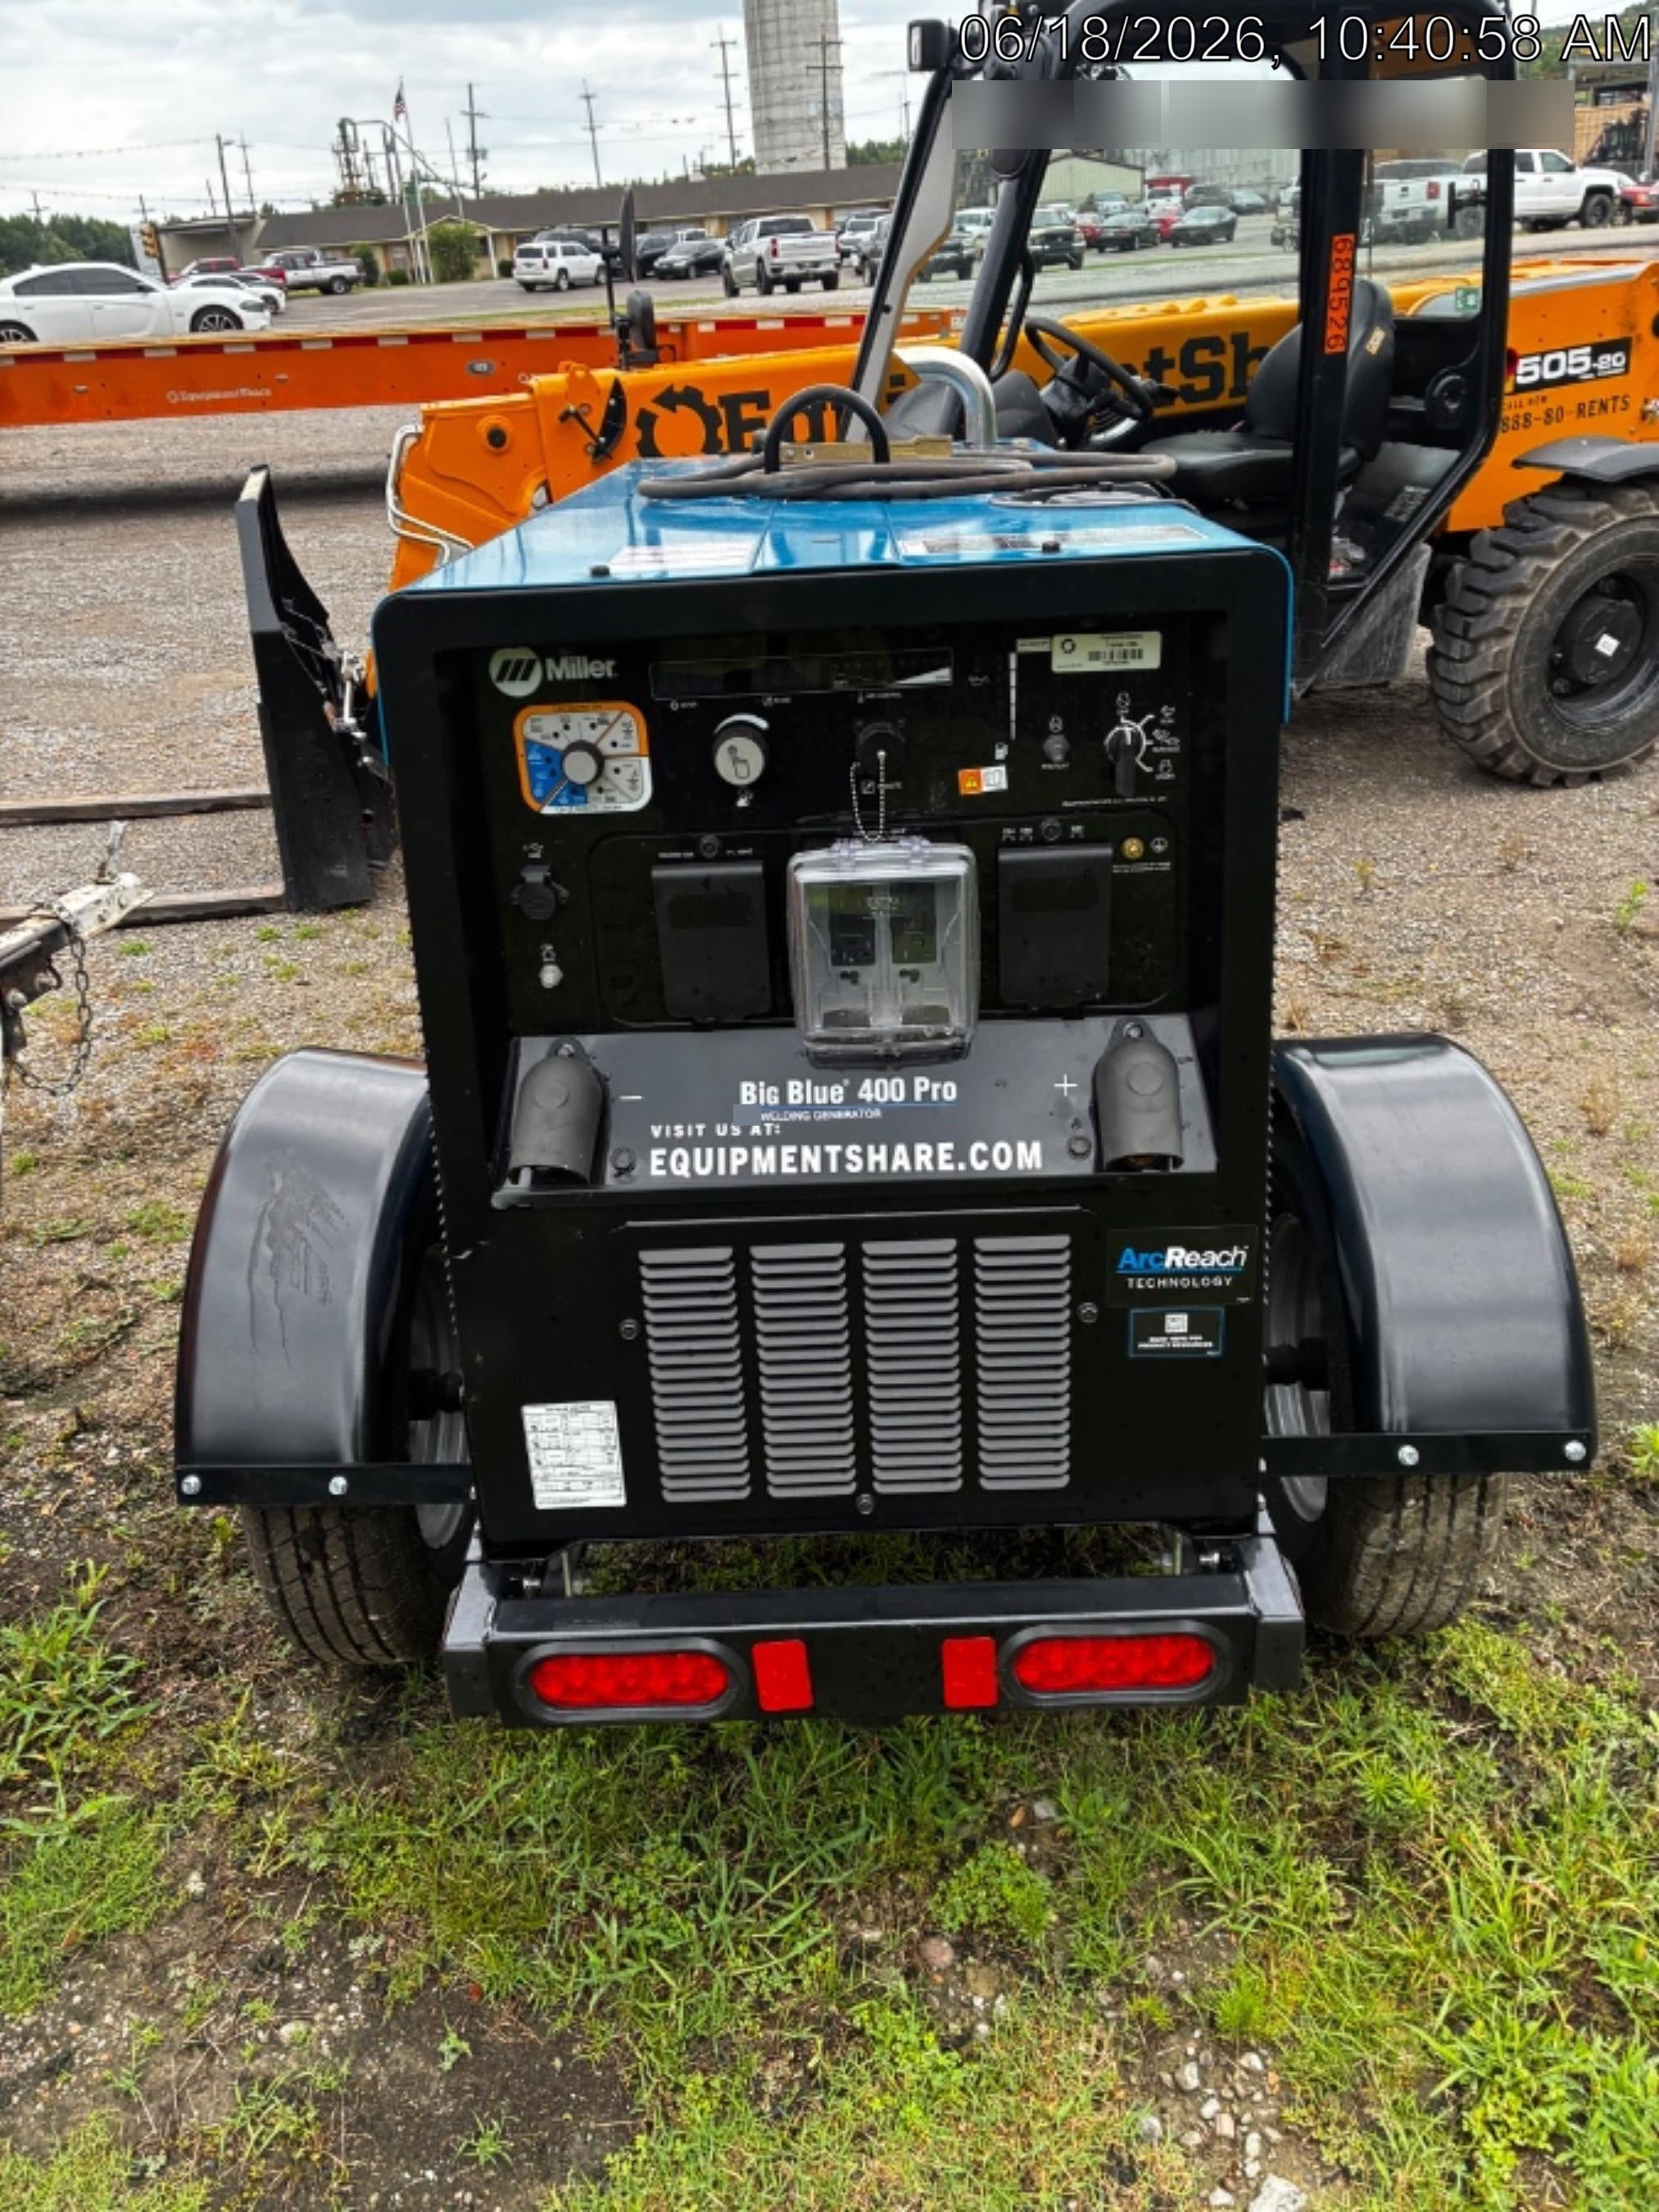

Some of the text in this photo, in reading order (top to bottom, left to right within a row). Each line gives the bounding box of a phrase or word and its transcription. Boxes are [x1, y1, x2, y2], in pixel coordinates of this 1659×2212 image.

[545, 656, 619, 682] Miller
[741, 1081, 779, 1105] Big
[858, 1077, 906, 1102] 400
[913, 1077, 957, 1102] Pro
[650, 1122, 781, 1139] VISIT US AT:
[650, 1141, 1043, 1178] EQUIPMENTSHARE.COM
[1117, 1245, 1249, 1271] ArcReach
[1126, 1276, 1234, 1290] TECHNOLOGY
